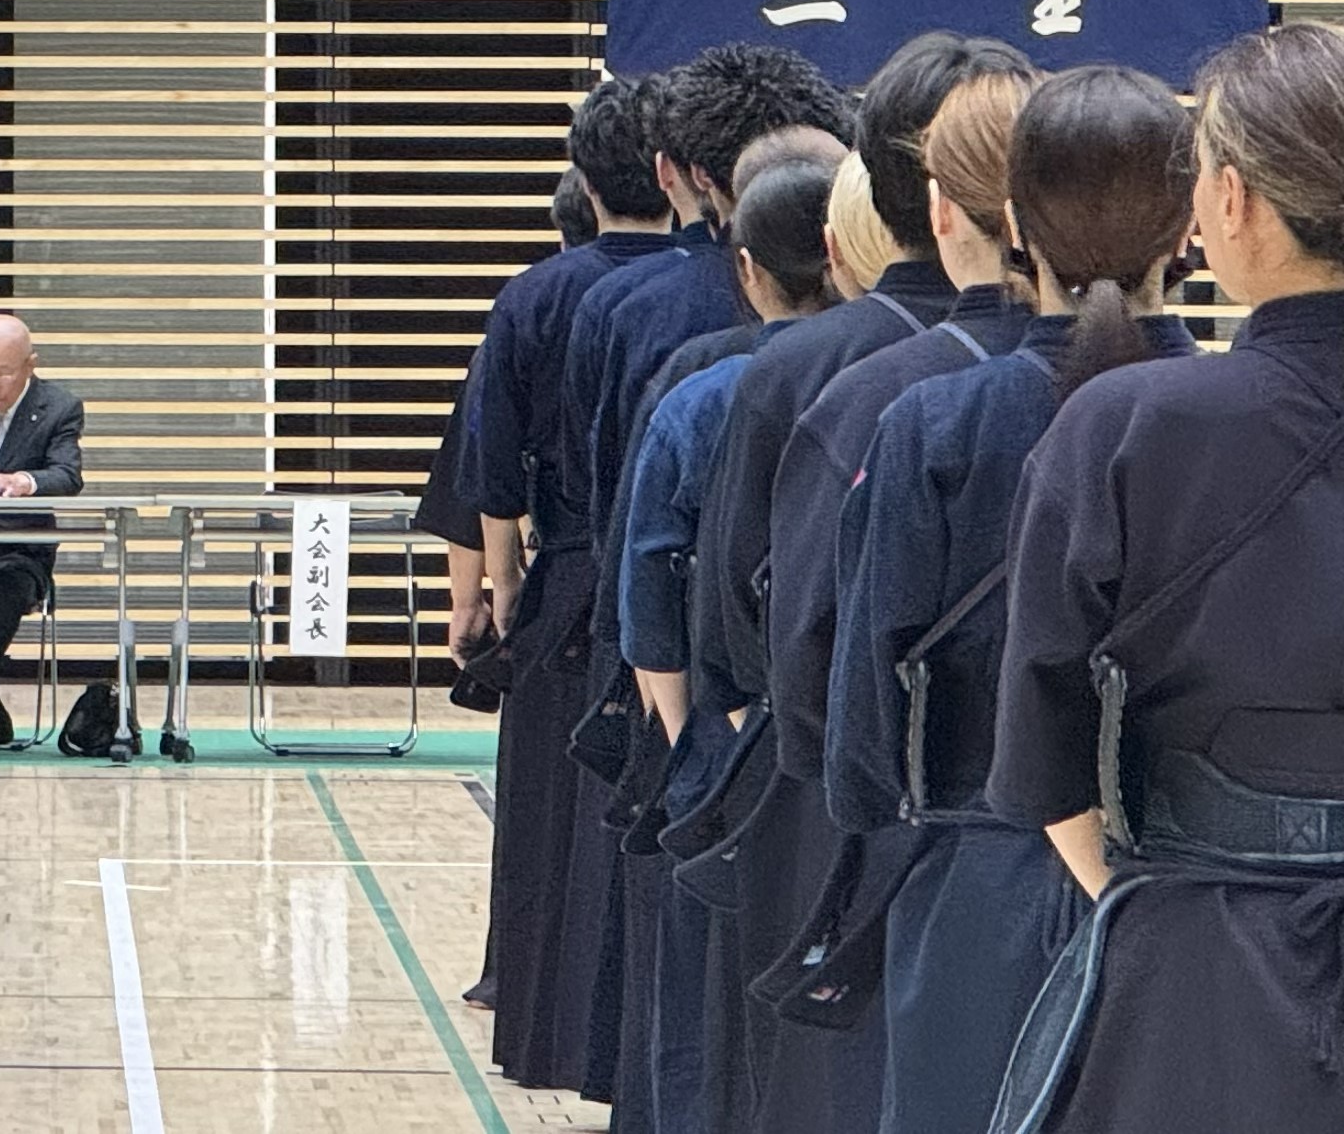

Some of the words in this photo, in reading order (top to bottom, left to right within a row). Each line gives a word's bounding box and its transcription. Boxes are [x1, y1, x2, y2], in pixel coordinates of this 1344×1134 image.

[305, 513, 331, 640] 大会副会長
